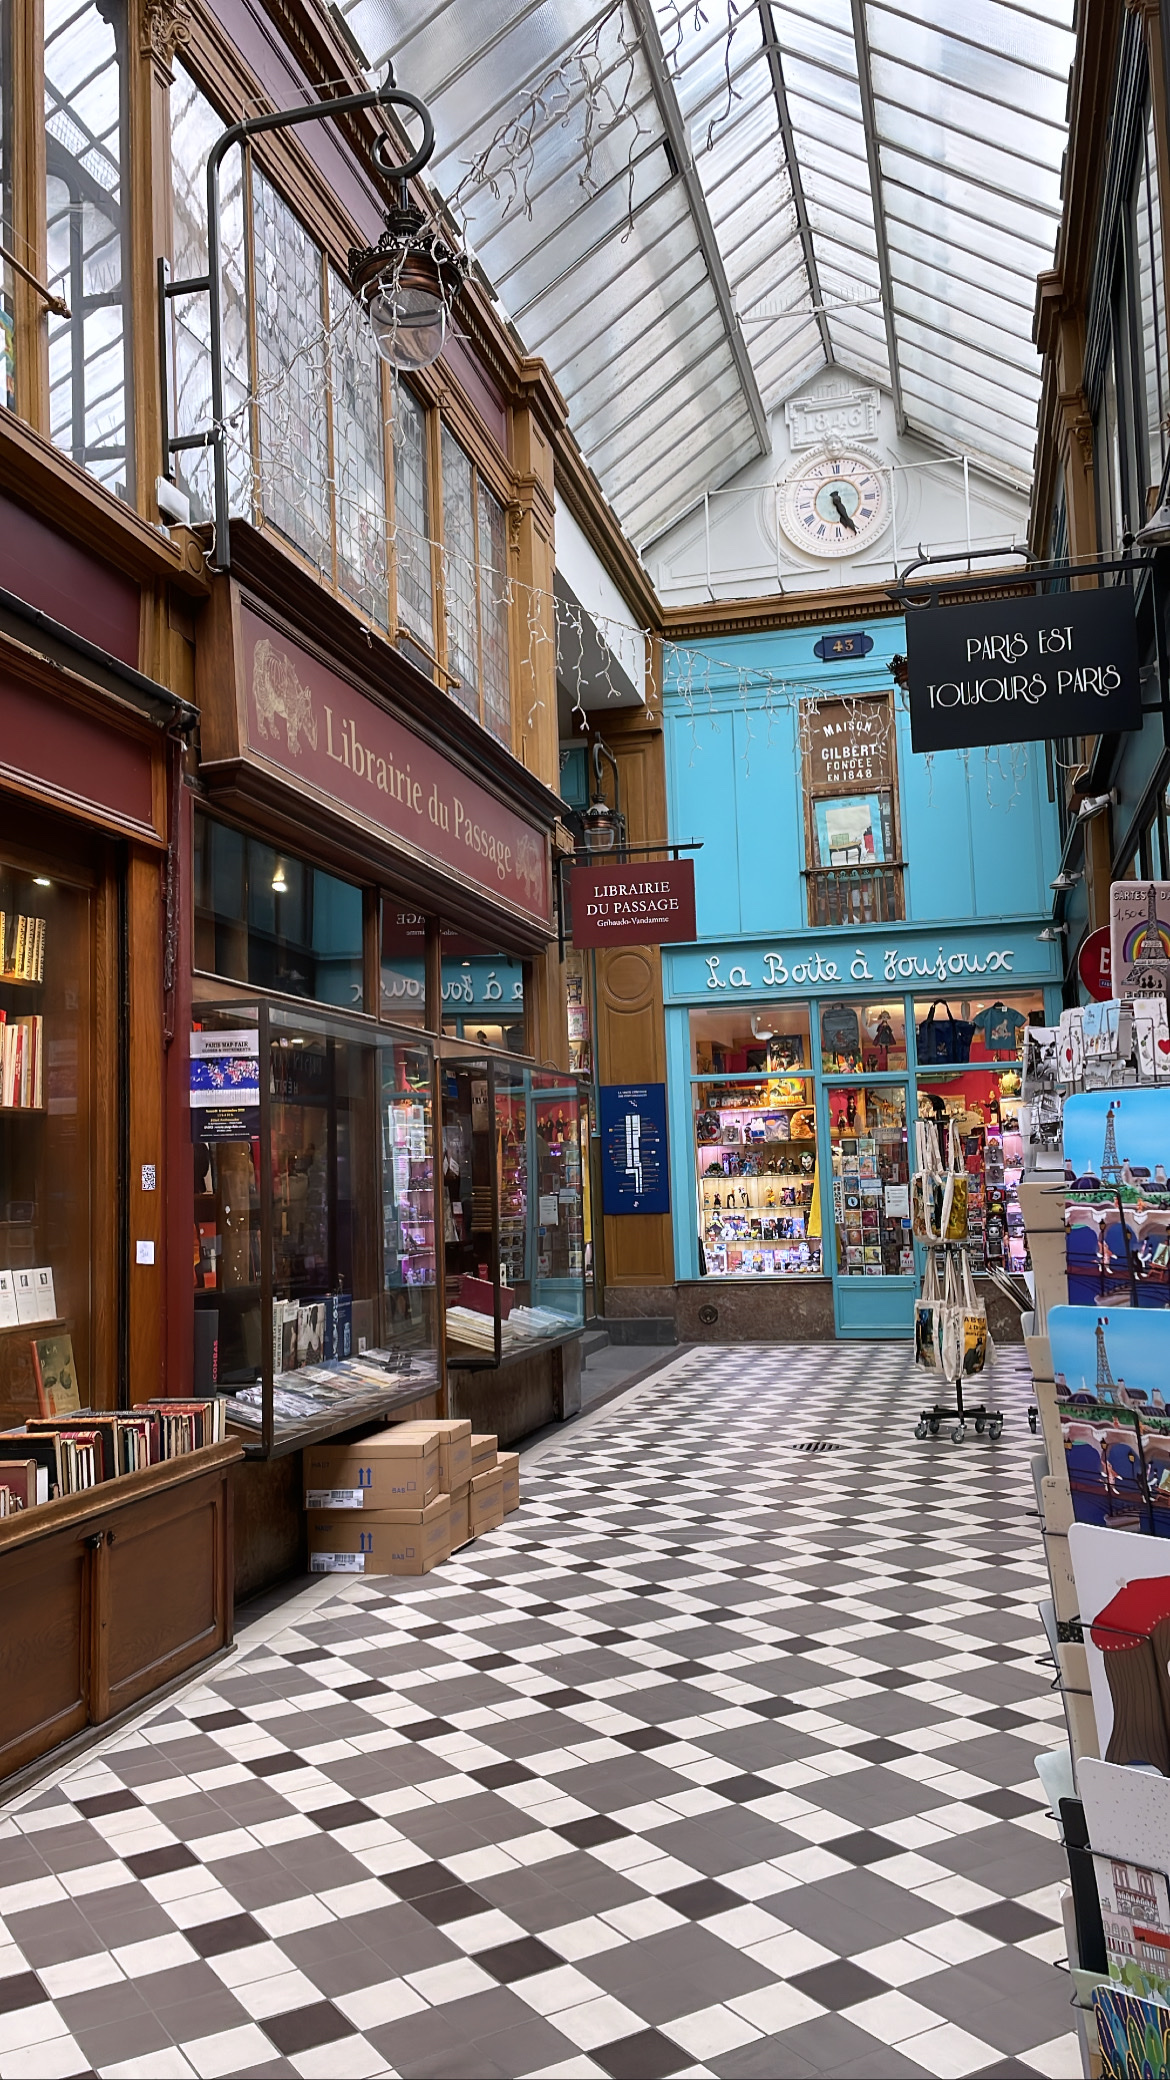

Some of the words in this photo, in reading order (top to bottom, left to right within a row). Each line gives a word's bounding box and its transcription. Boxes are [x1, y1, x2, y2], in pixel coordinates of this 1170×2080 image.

[967, 633, 1028, 664] PARIS
[1038, 626, 1074, 654] EST
[927, 673, 1047, 709] TOUJOURS
[1058, 665, 1121, 697] PARIS
[823, 721, 872, 738] MAISON
[821, 744, 876, 760] GILBERT
[828, 773, 840, 782] EN
[843, 769, 873, 781] 1848
[324, 705, 423, 815] Librairie
[428, 783, 450, 833] du
[453, 797, 513, 880] Passage
[594, 881, 670, 898] LIBRAIRIE
[1114, 890, 1147, 900] CARTES
[587, 903, 609, 916] DU
[614, 898, 679, 914] PASSAGE
[705, 956, 751, 989] La
[850, 949, 874, 981] à
[884, 946, 1015, 981] Joujoux
